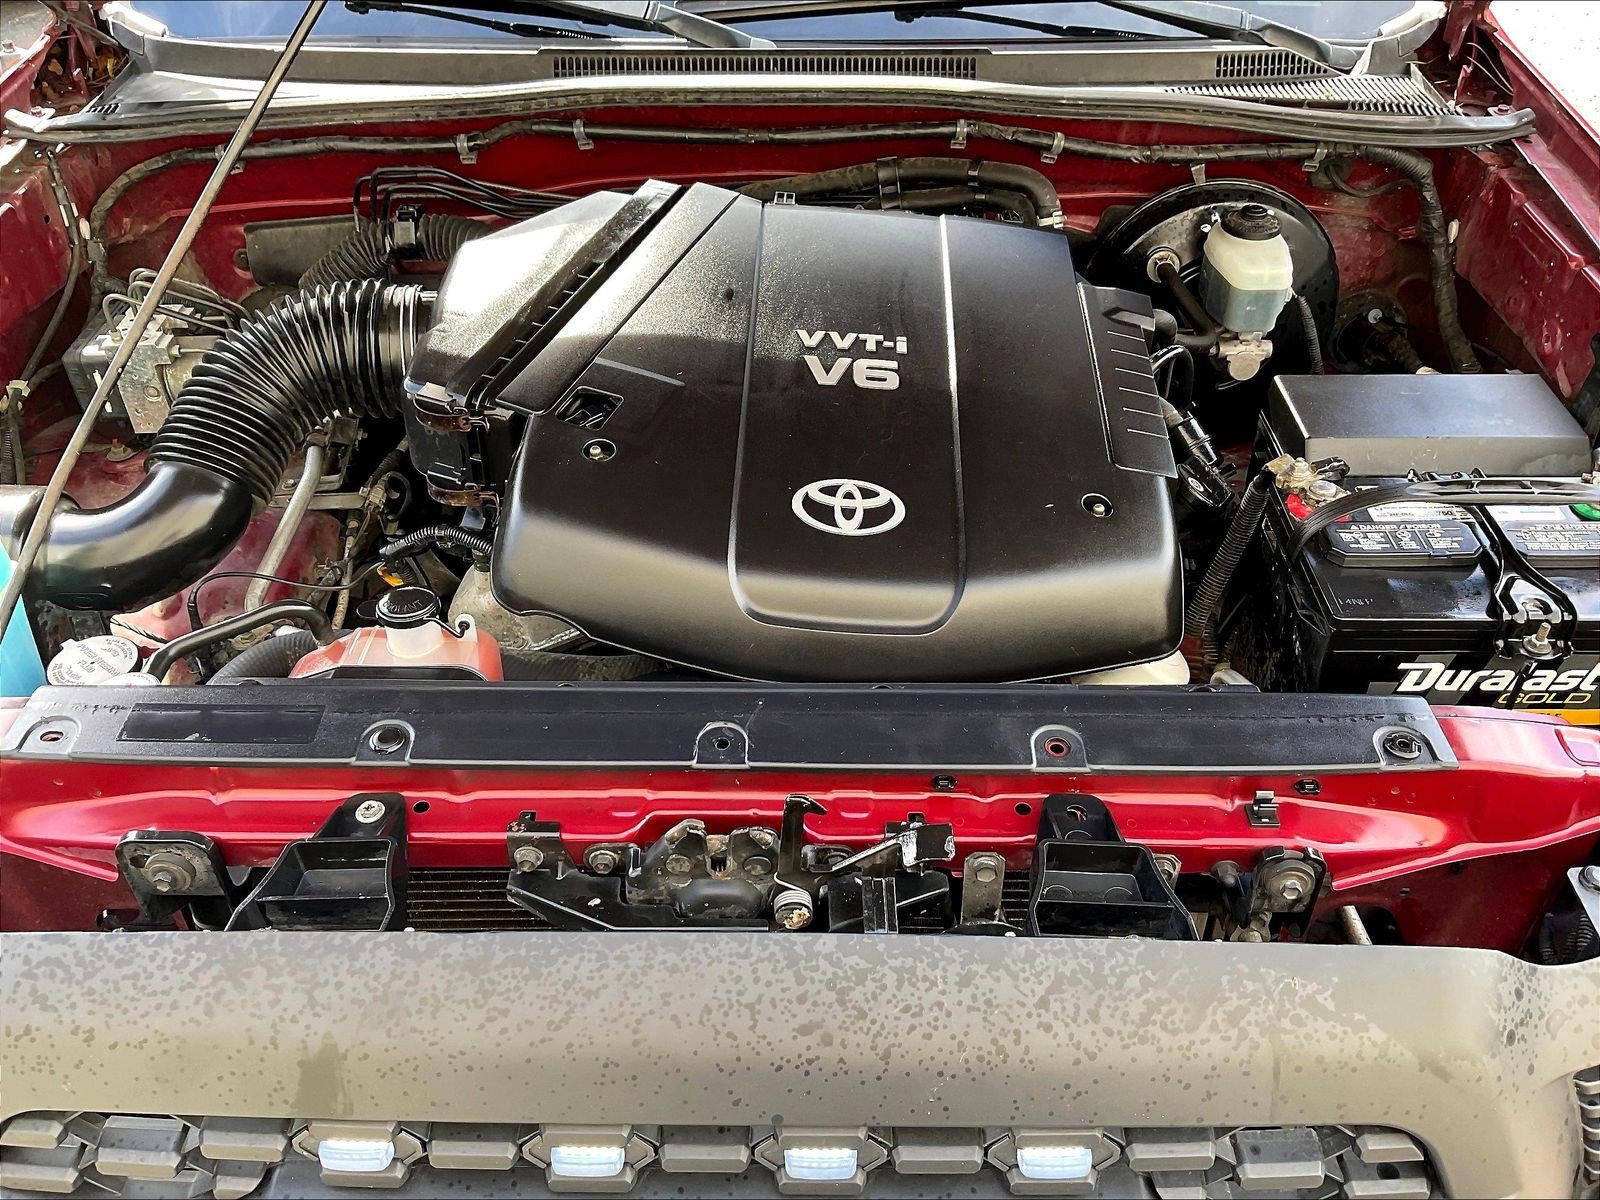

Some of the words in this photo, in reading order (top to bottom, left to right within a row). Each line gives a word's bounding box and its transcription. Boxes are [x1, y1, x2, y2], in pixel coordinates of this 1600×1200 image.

[795, 329, 908, 354] VVT-i
[802, 355, 900, 390] V6
[1497, 693, 1592, 704] GOLD
